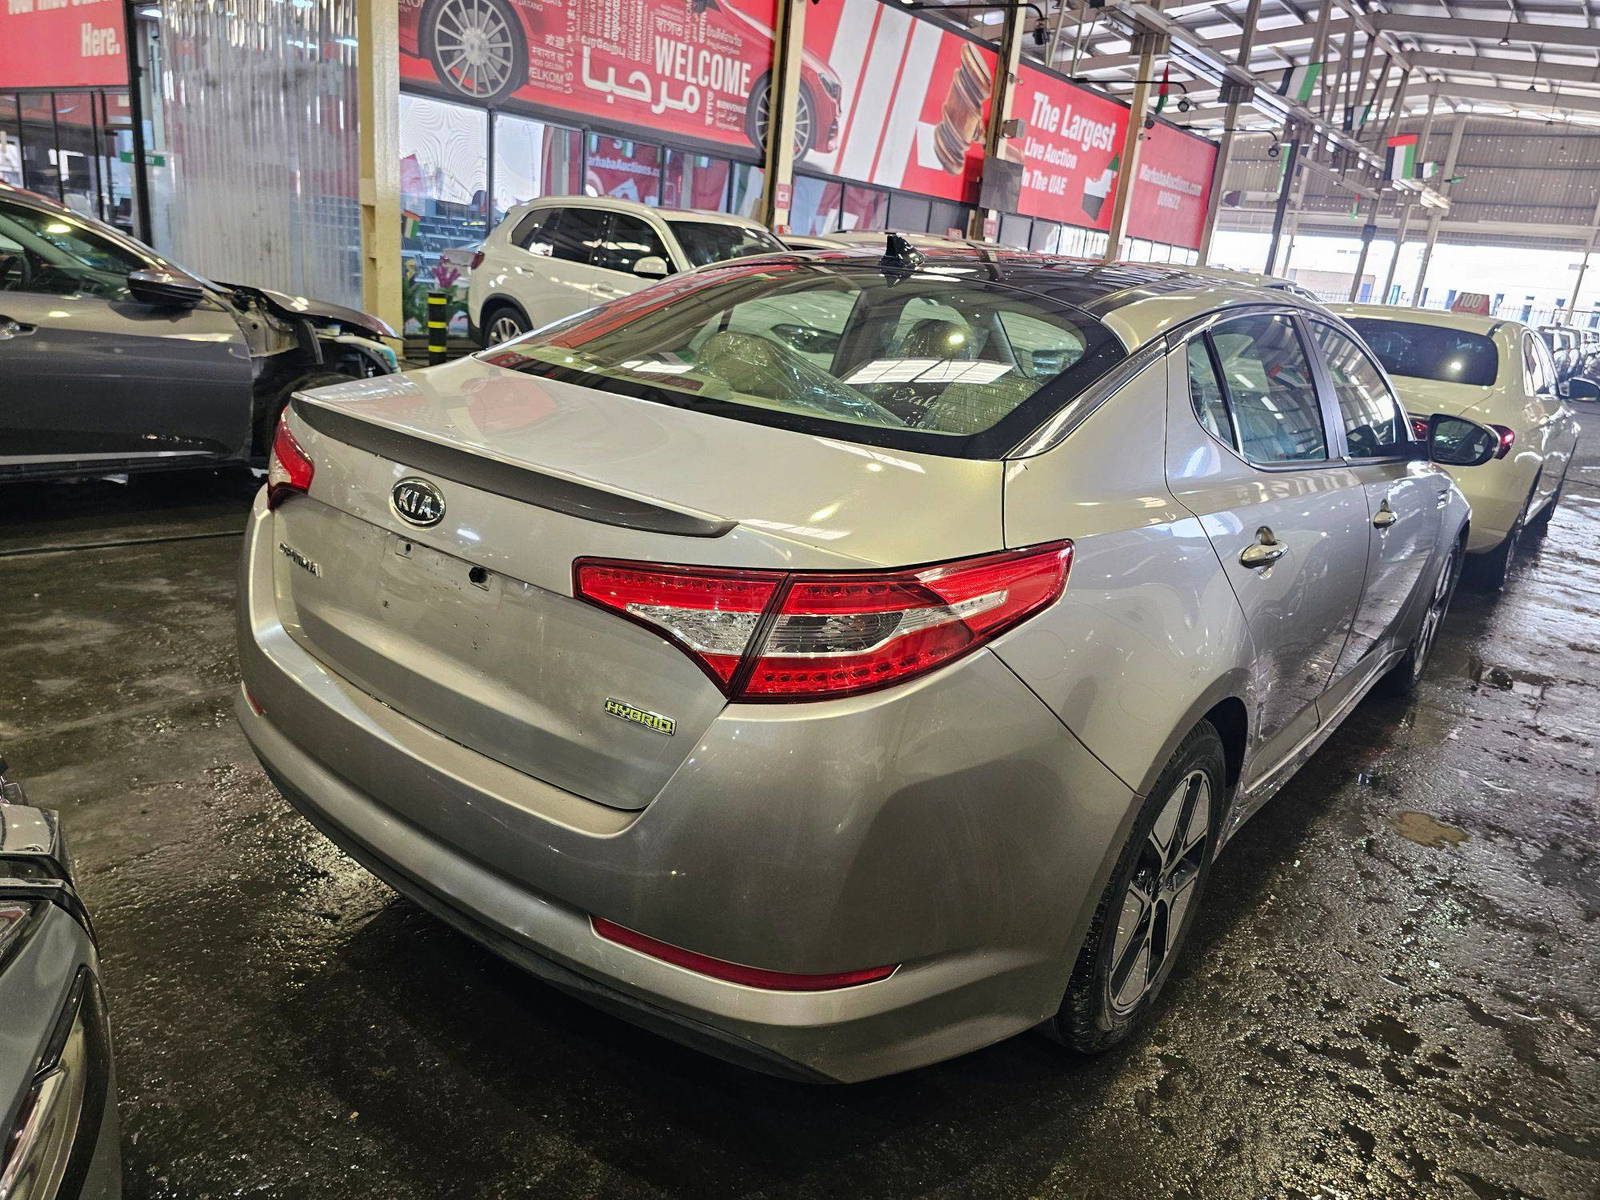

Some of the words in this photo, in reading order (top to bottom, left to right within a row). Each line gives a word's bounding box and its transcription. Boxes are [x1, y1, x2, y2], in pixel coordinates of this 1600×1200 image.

[80, 22, 121, 57] Here.
[582, 46, 700, 114] مرحبا
[655, 35, 751, 98] WELCOME
[1030, 91, 1060, 133] The
[1060, 104, 1117, 152] Largest
[1024, 136, 1045, 160] Live
[1043, 143, 1078, 169] Auction
[1031, 169, 1049, 191] The
[1048, 174, 1068, 195] UAE
[398, 486, 435, 519] KIA
[606, 701, 672, 733] HYBRID
